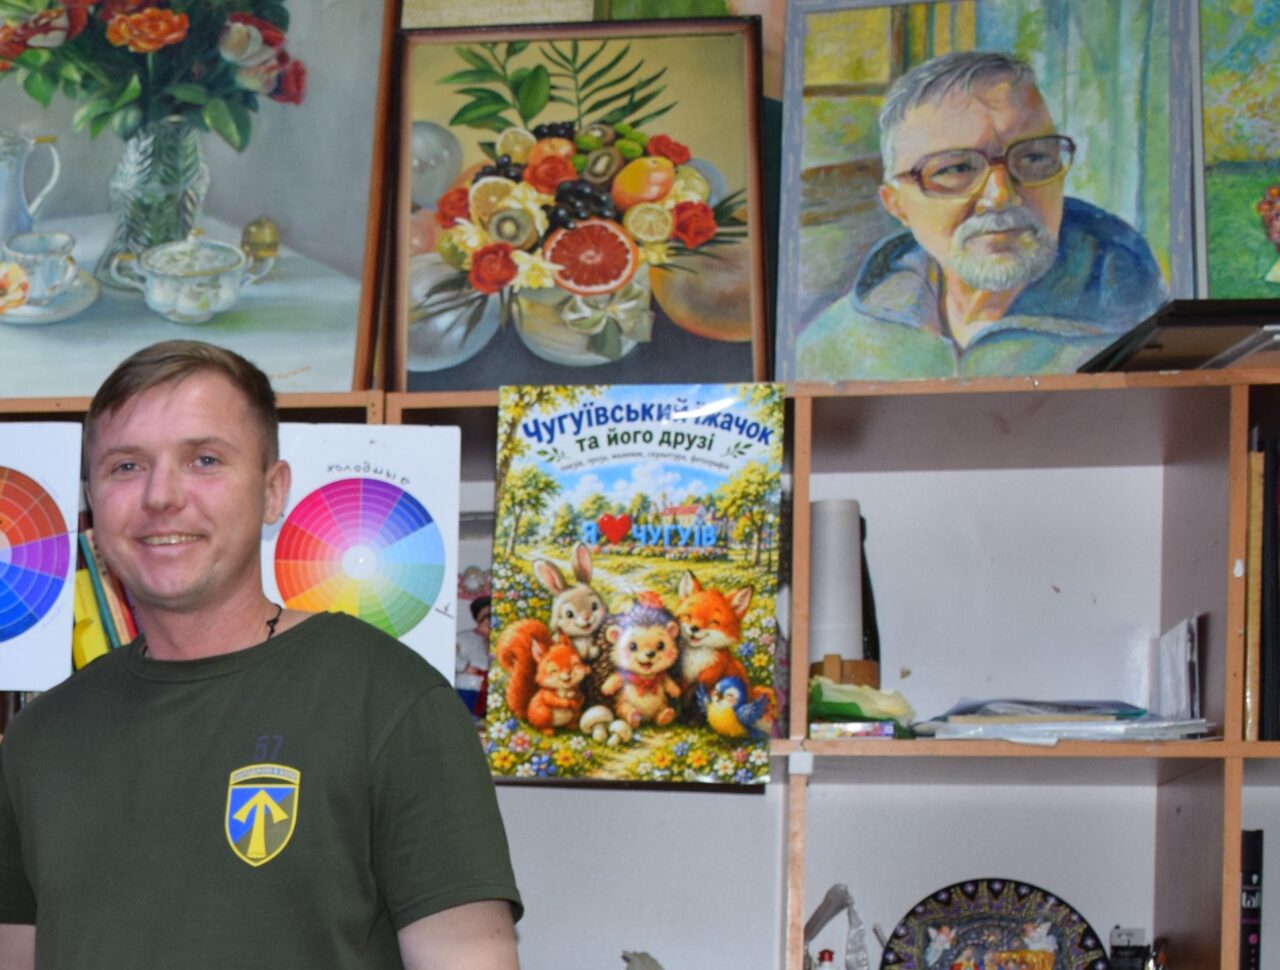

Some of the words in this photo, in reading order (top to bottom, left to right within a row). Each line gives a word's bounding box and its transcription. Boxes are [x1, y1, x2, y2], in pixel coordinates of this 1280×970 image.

[522, 398, 688, 445] Чугуївський
[576, 435, 600, 452] та
[607, 428, 653, 446] його
[659, 430, 716, 451] друзі
[581, 521, 598, 546] Я
